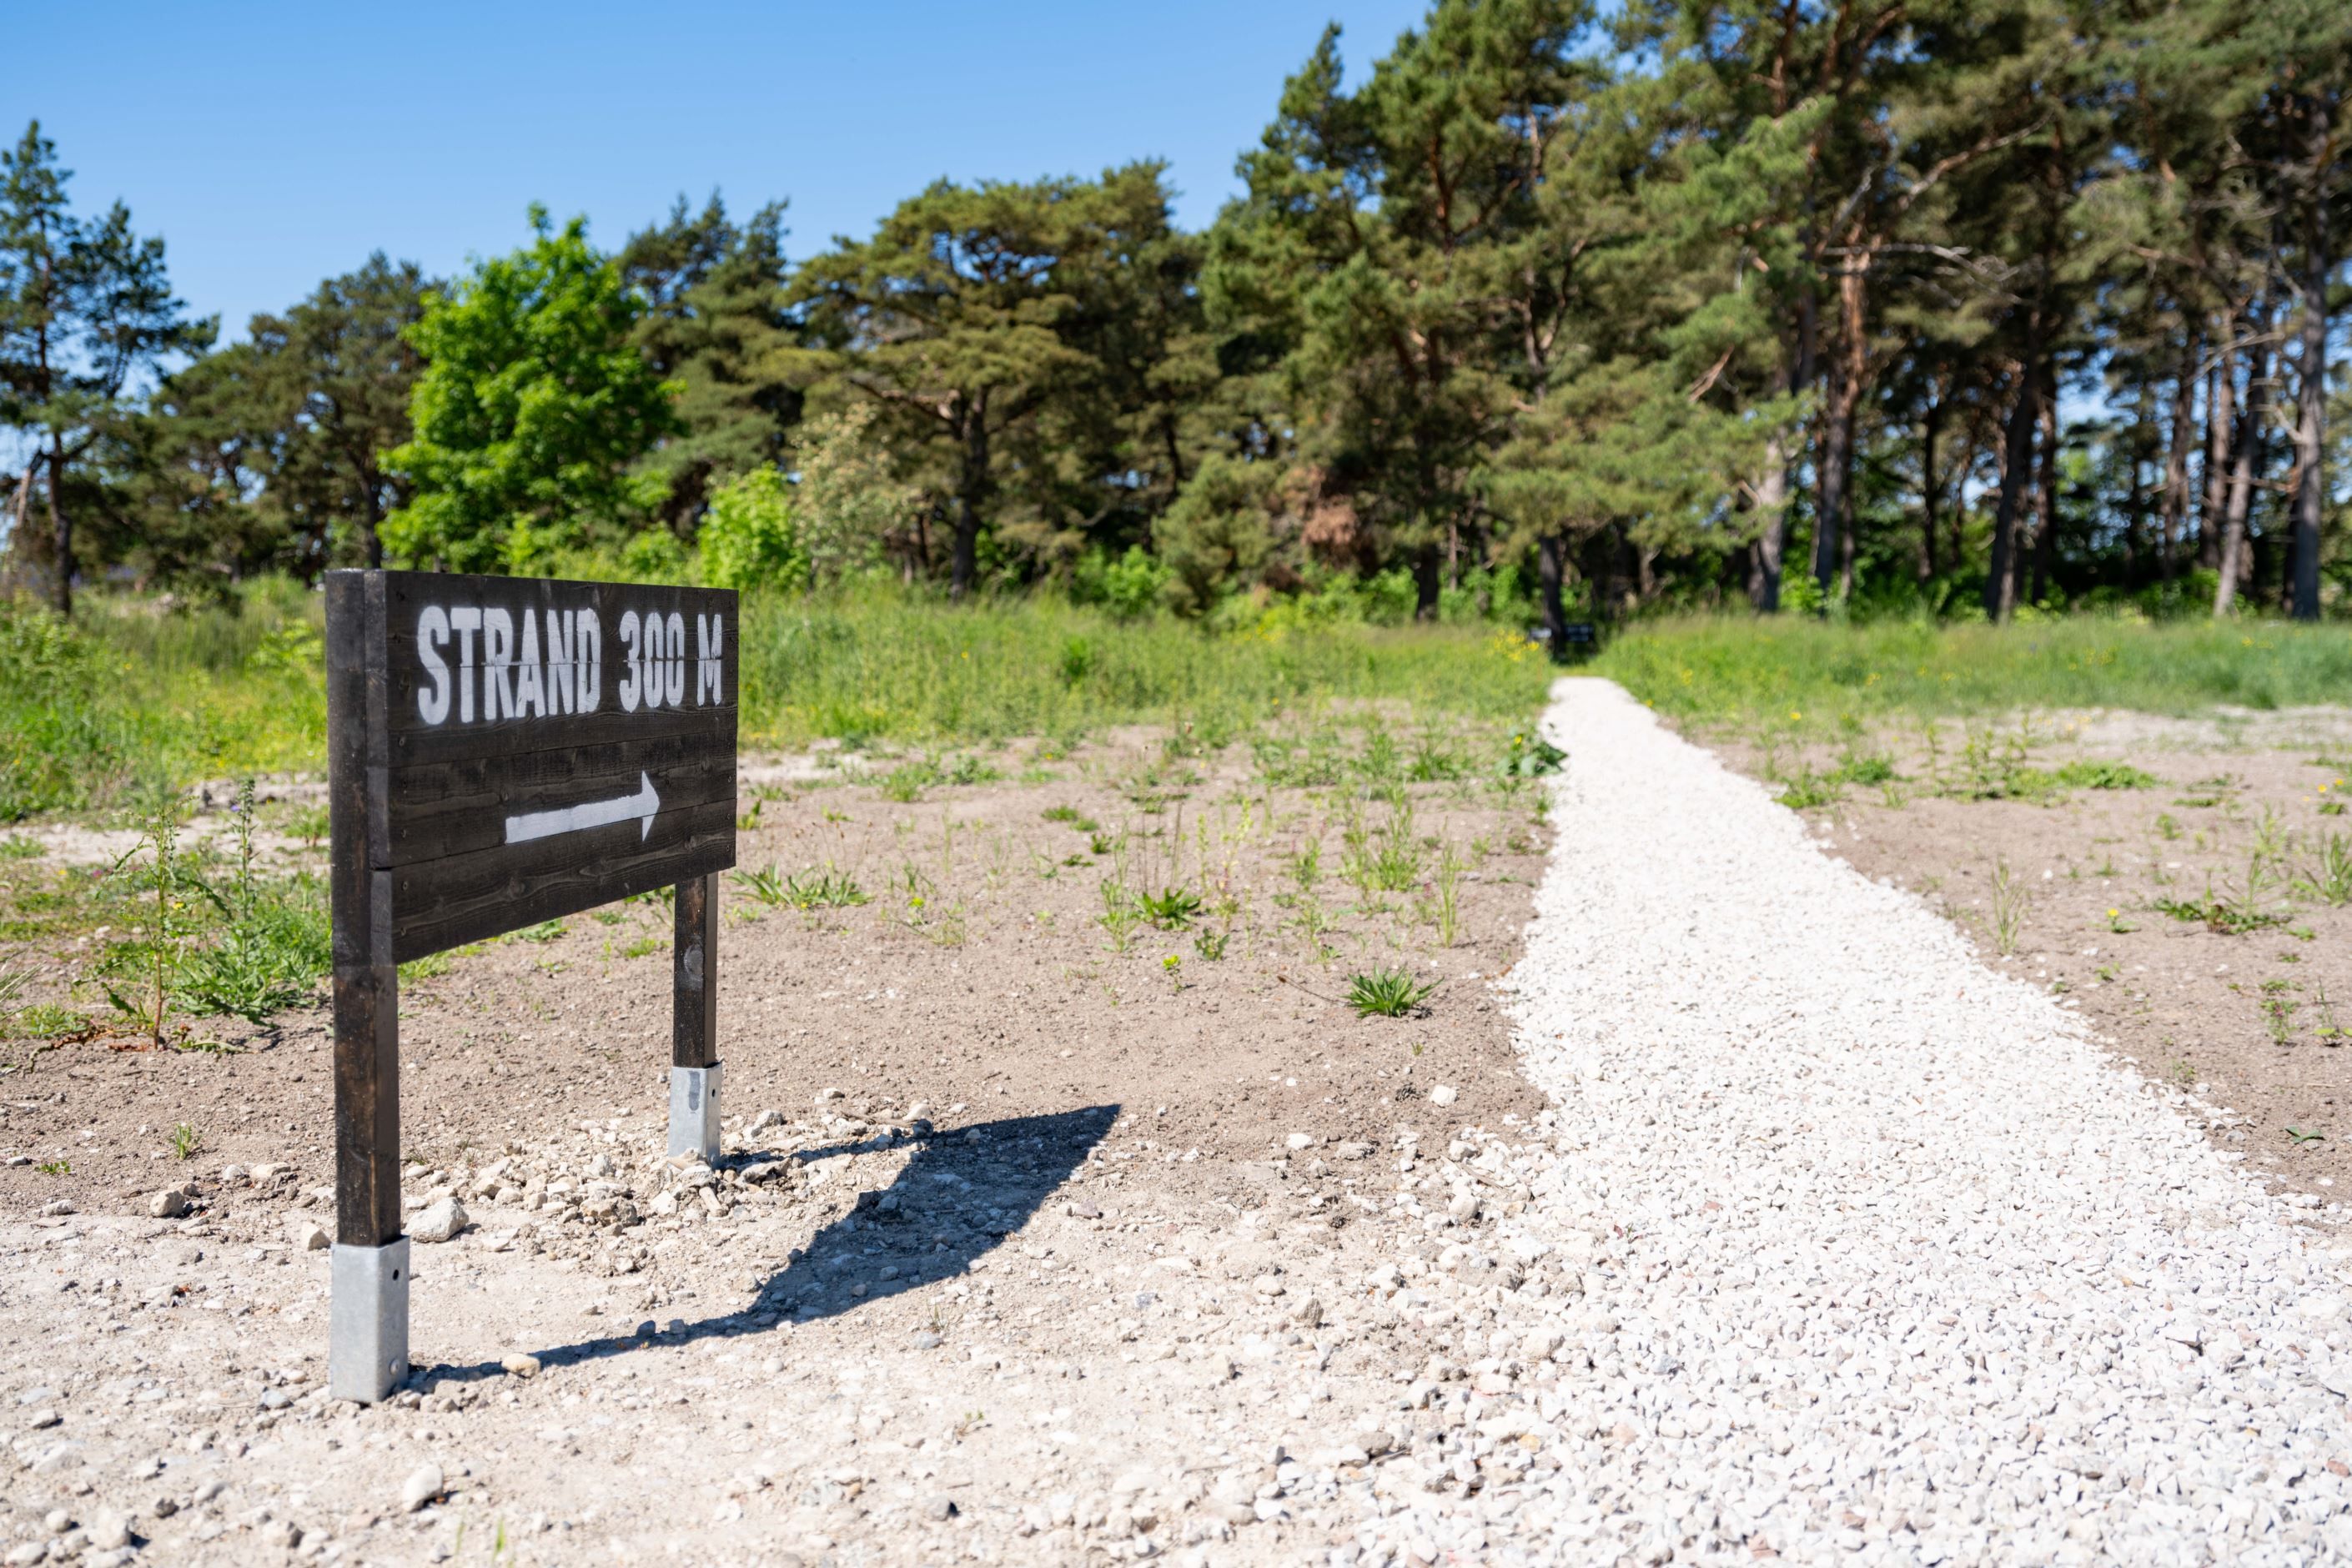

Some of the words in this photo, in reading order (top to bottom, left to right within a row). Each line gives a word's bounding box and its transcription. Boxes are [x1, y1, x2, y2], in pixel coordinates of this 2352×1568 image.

[416, 606, 601, 725] STRAND
[619, 610, 686, 713] 300
[697, 613, 722, 707] M
